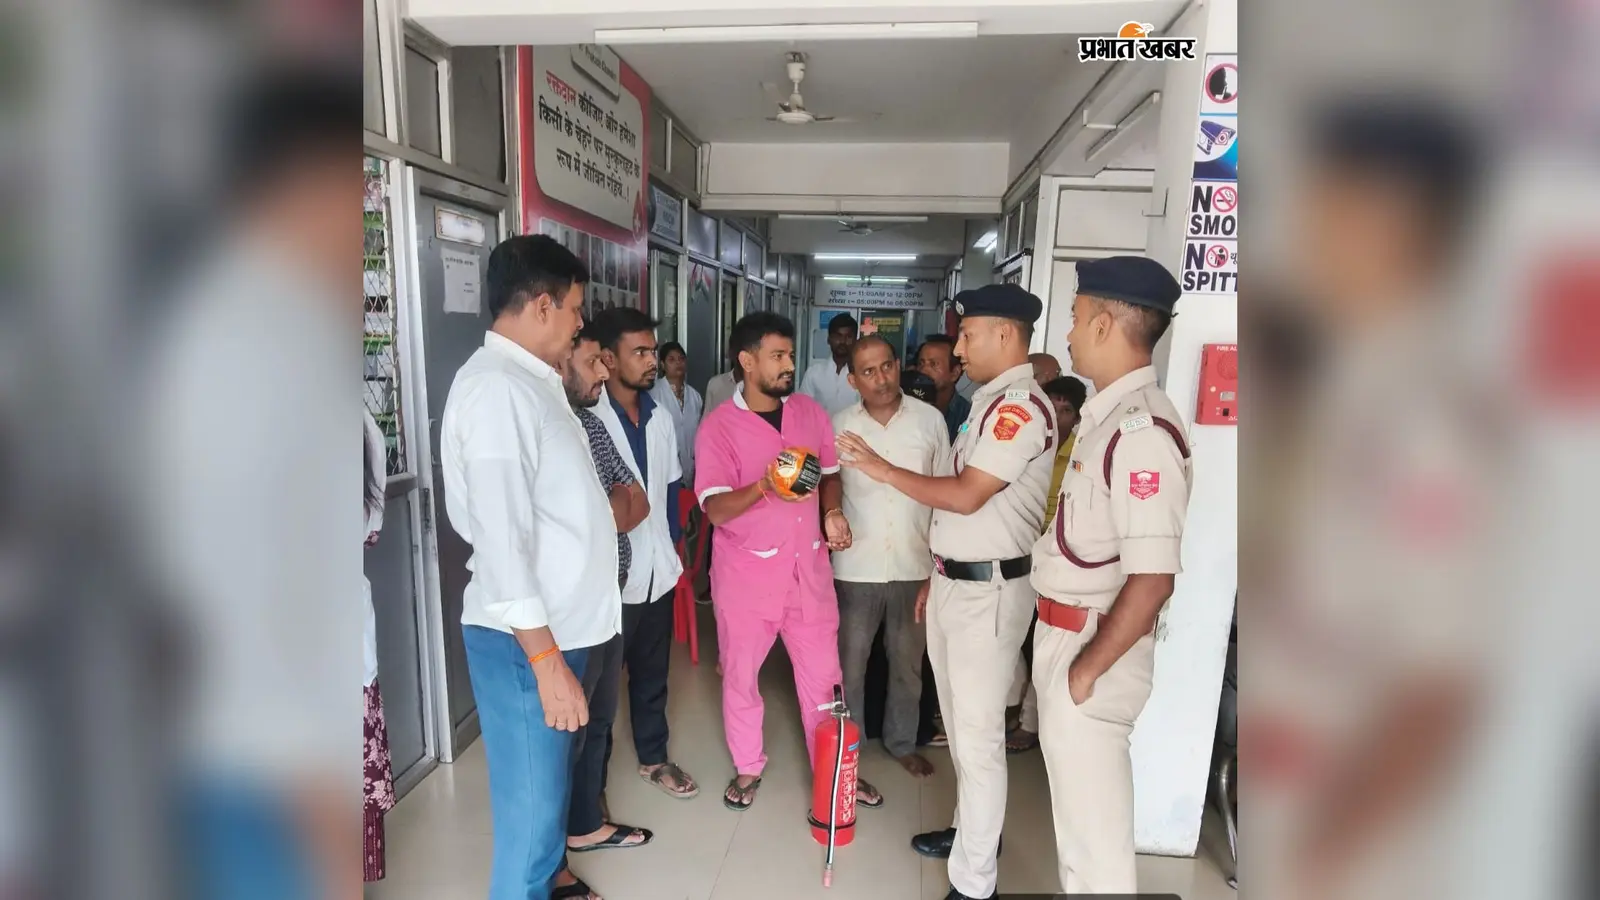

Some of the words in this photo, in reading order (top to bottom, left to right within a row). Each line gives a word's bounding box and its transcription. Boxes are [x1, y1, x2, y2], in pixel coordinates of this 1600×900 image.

[539, 94, 562, 132] किसी
[564, 111, 573, 137] के
[575, 119, 592, 151] चेहरे
[593, 136, 603, 155] पर
[546, 70, 577, 107] रक्तदान
[578, 91, 603, 127] कीजिए
[605, 110, 618, 136] और
[619, 121, 636, 148] हमेशा
[556, 148, 572, 172] रूप
